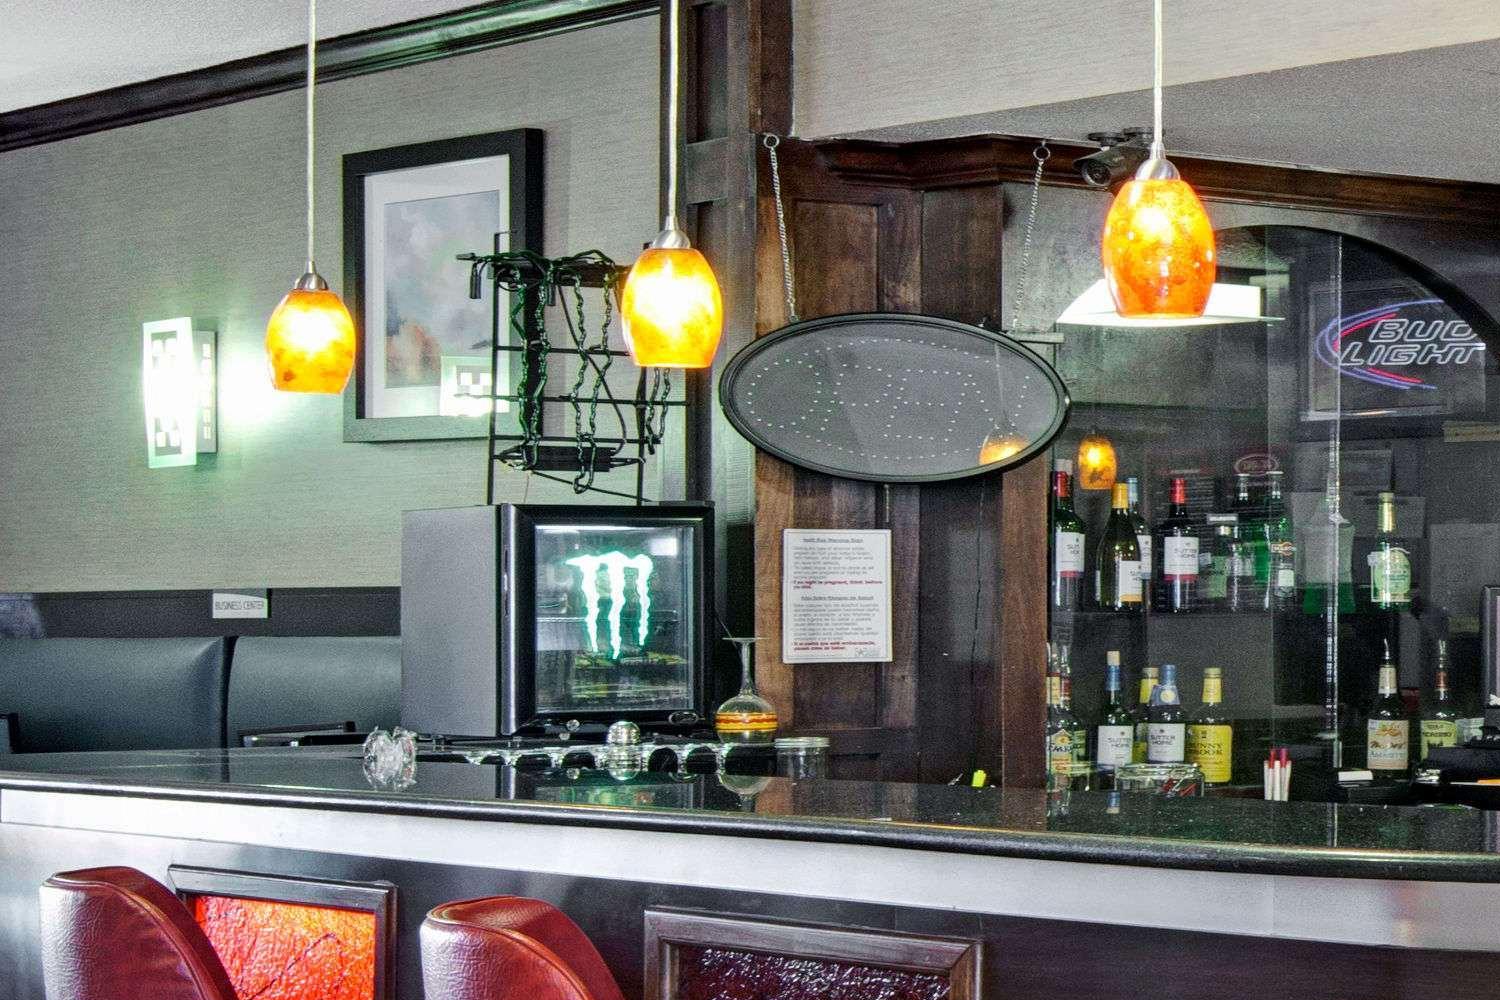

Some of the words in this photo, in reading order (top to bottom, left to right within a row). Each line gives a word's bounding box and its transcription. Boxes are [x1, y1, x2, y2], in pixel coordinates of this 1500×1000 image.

[1368, 318, 1479, 342] BUD
[1340, 342, 1487, 365] LIGHT
[215, 600, 242, 610] BUSINESS
[244, 600, 265, 610] CENTER
